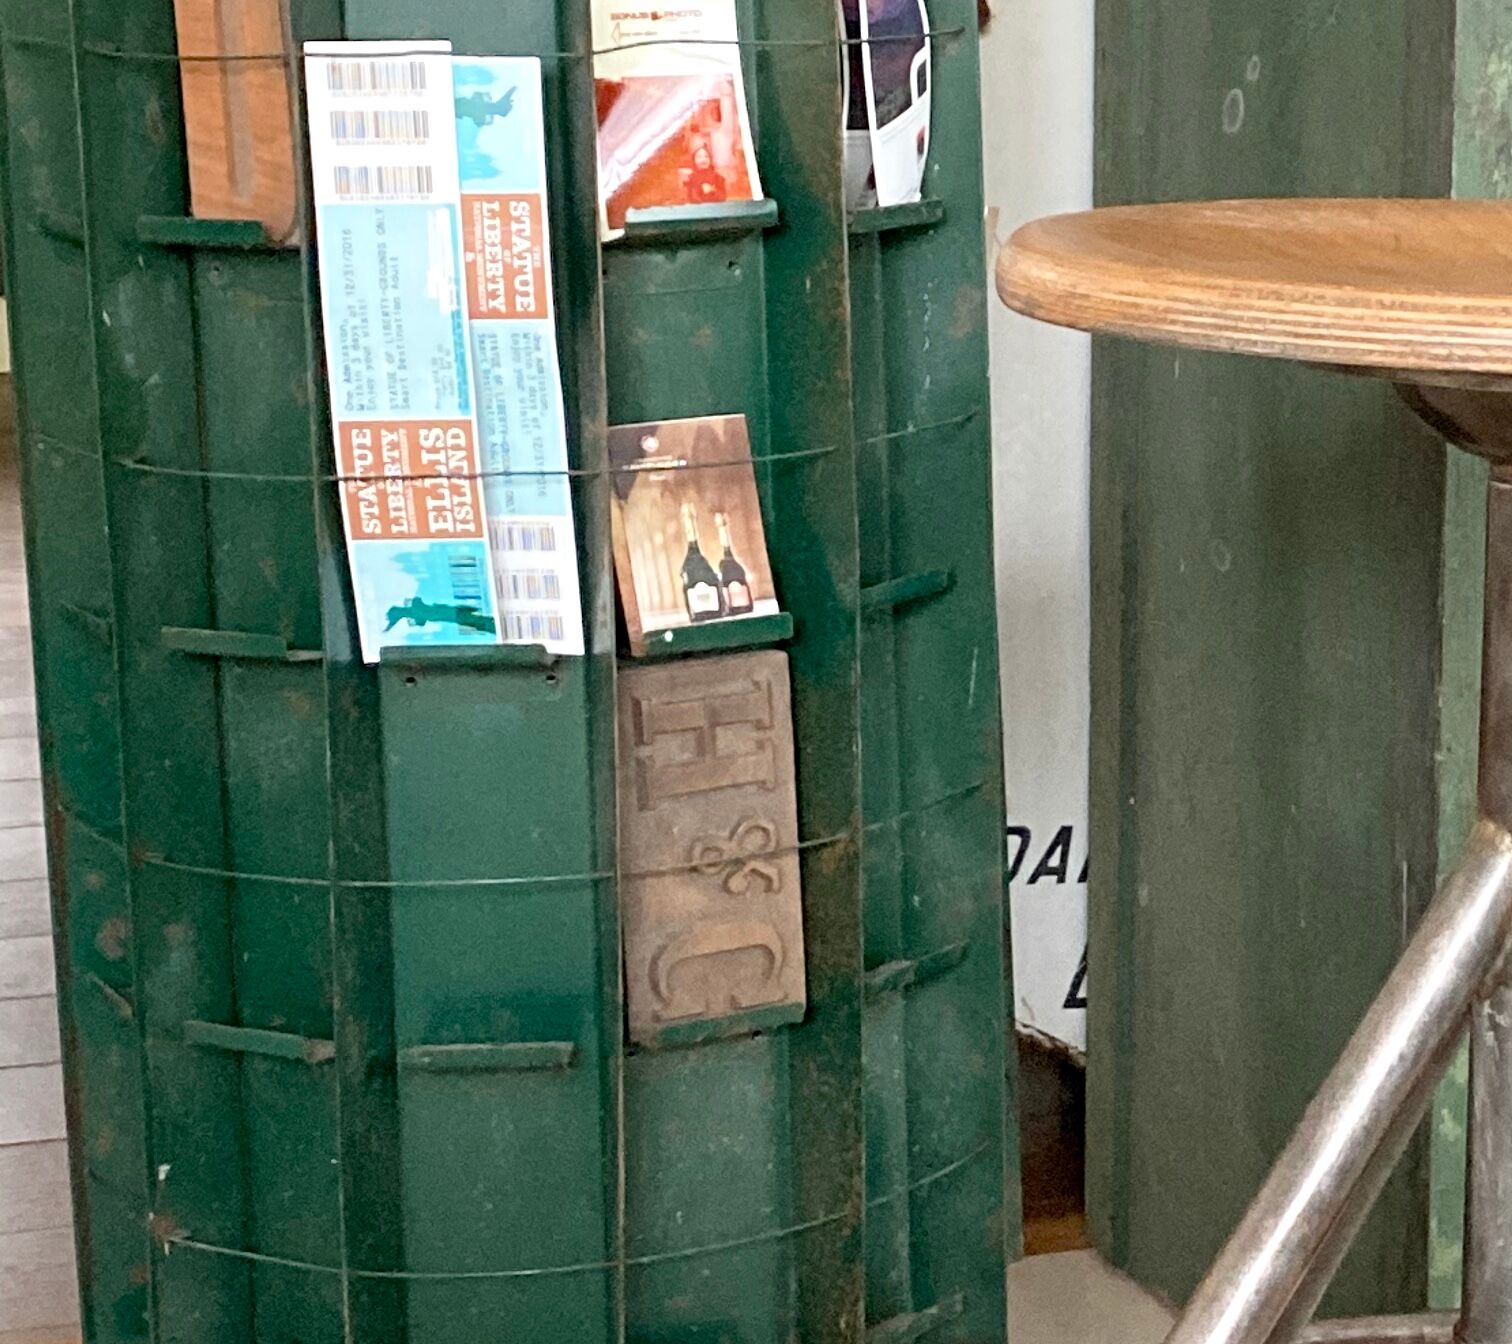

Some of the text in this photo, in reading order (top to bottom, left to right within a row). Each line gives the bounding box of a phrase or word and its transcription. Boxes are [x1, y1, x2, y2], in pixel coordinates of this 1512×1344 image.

[482, 200, 507, 314] LIBERTY
[509, 200, 537, 313] STATUE
[351, 428, 382, 534] STATUE
[380, 427, 409, 534] LIBERTY
[418, 427, 455, 533] ELLIS
[445, 427, 476, 533] ISLAND
